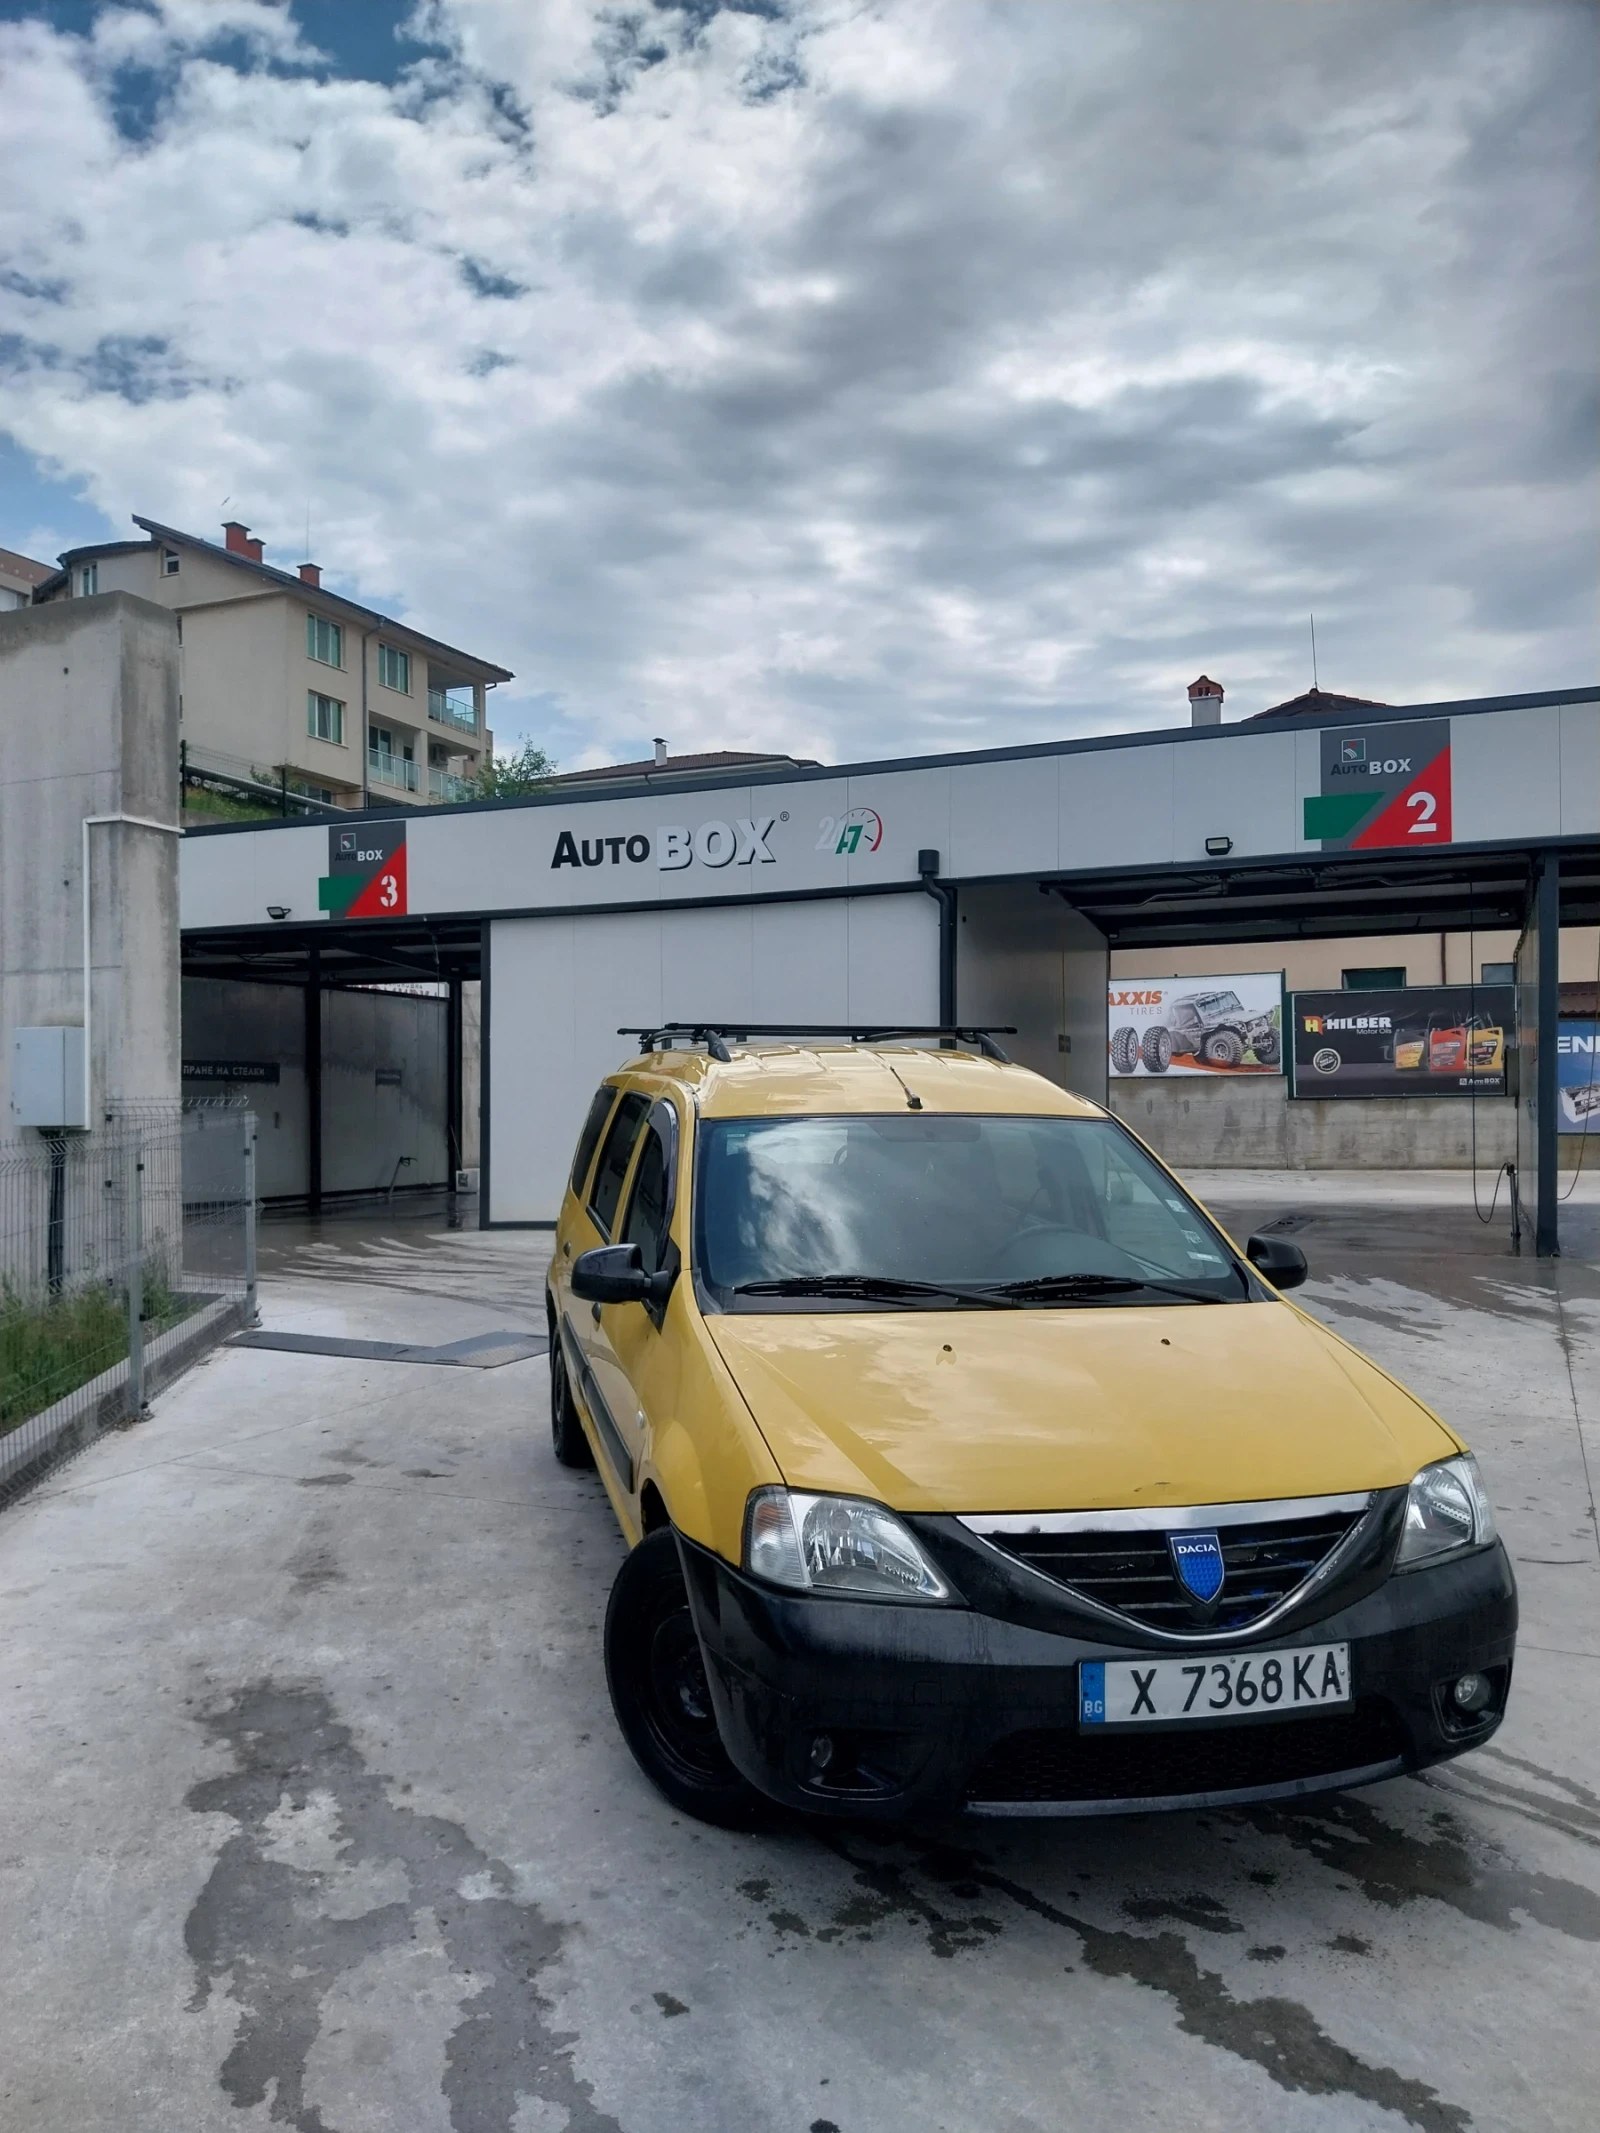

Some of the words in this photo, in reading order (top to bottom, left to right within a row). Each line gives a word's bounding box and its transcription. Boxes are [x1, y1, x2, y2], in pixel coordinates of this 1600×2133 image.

[1406, 791, 1437, 834] 2
[380, 874, 398, 907] 3
[1130, 1006, 1163, 1015] TIRES
[1326, 1017, 1392, 1029] HILBER
[183, 1065, 213, 1075] ПРАНЕ
[217, 1066, 229, 1076] НА
[232, 1067, 265, 1077] СТЕЛКИ
[1177, 1544, 1217, 1554] DACIA
[1084, 1700, 1103, 1714] BG
[1130, 1668, 1157, 1715] X
